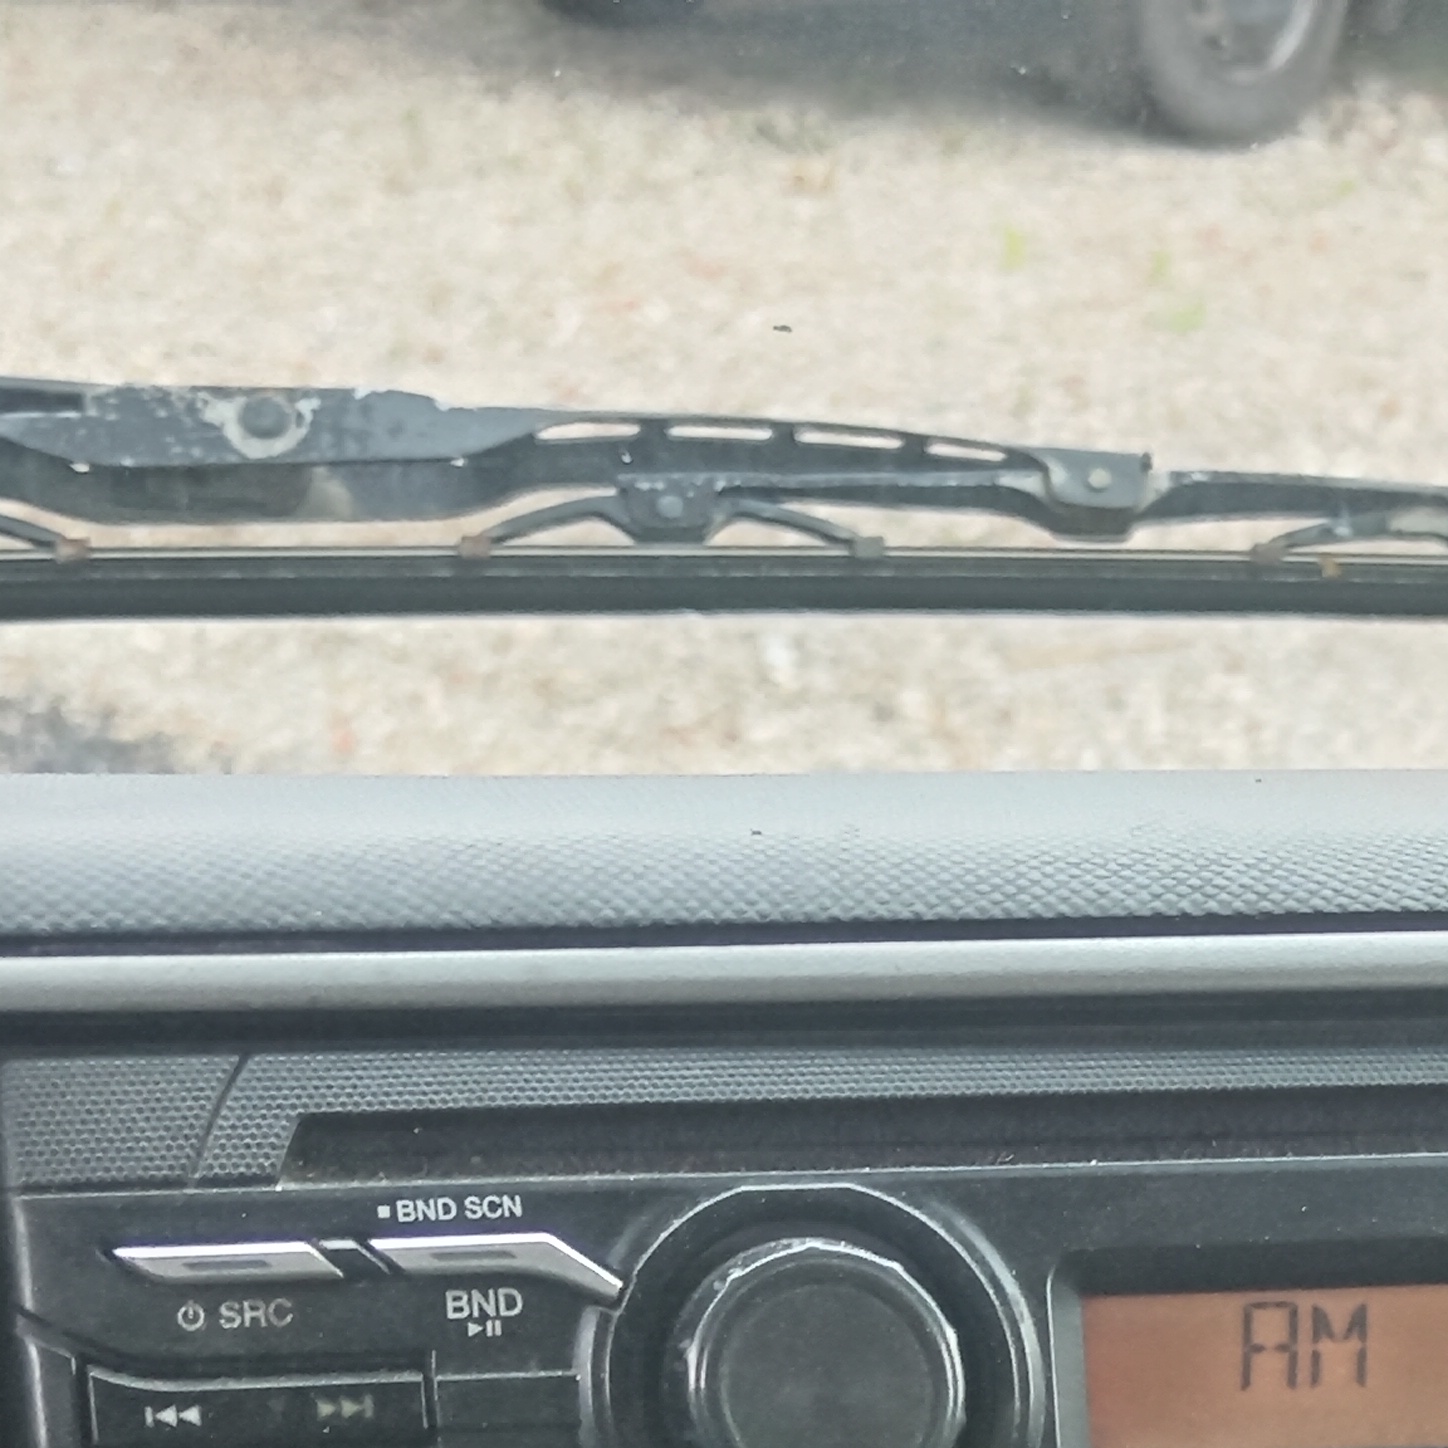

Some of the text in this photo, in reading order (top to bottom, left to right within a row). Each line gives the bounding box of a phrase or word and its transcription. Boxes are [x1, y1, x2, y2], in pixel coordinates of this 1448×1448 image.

[397, 1195, 522, 1223] BND SCN
[218, 1298, 293, 1329] SRC
[445, 1288, 523, 1319] BND
[1240, 1301, 1368, 1391] AM
